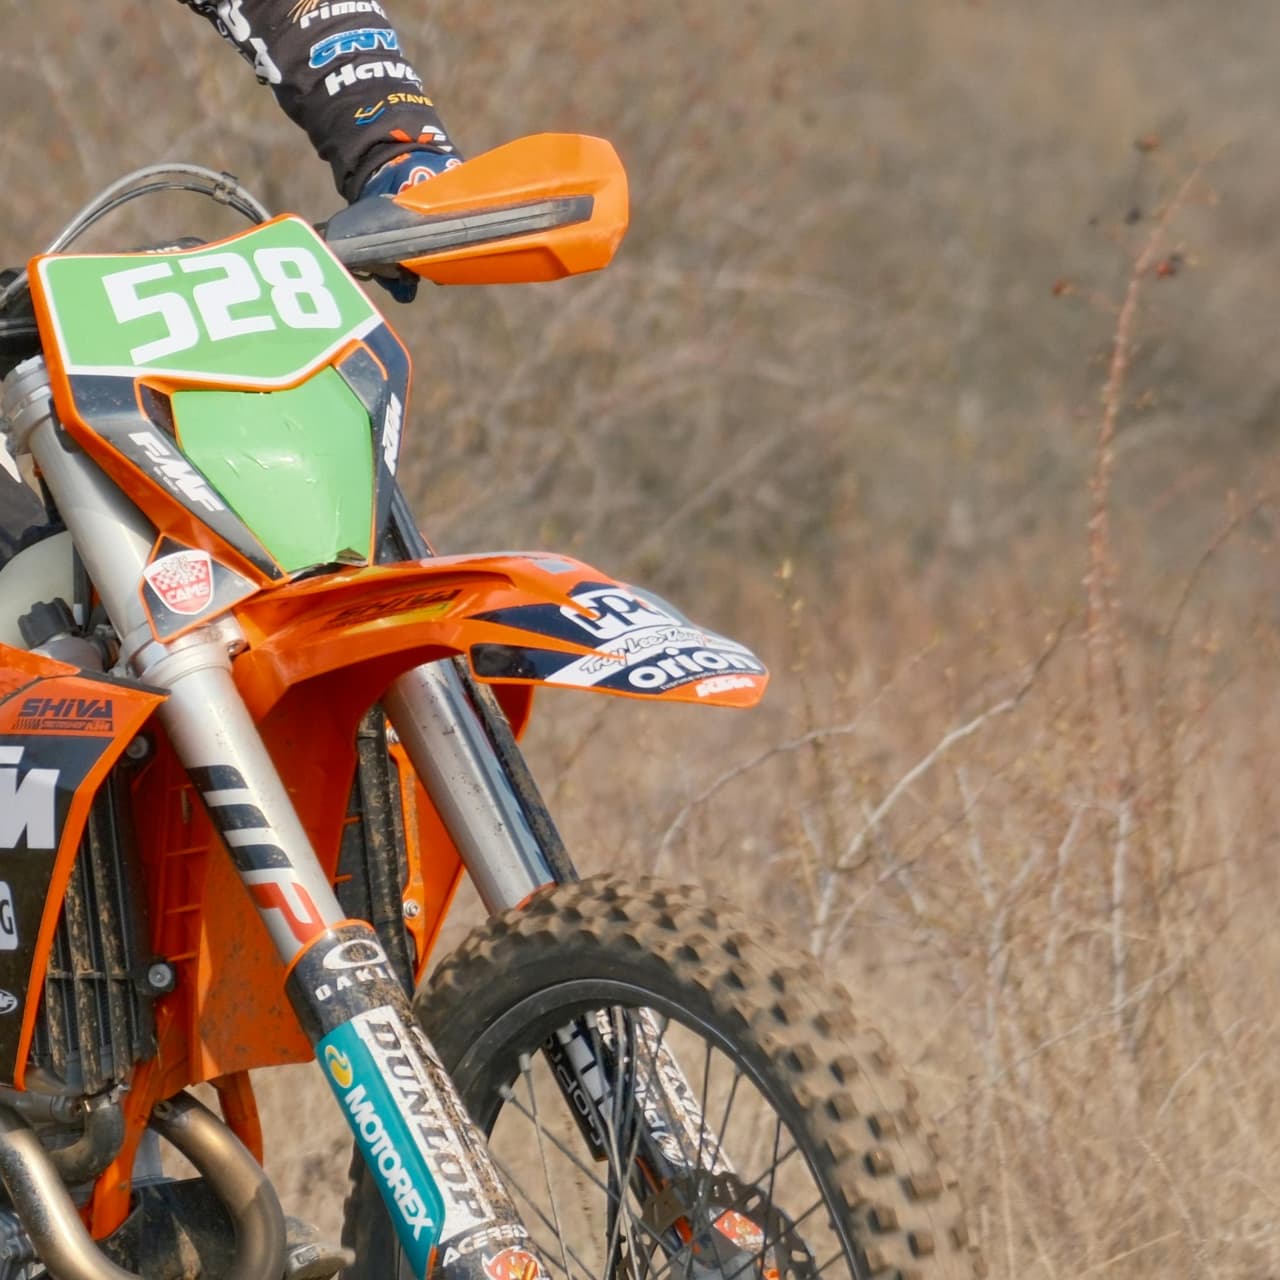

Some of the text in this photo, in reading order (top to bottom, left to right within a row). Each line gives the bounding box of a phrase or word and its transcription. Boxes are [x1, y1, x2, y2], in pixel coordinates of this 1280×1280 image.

[101, 247, 342, 366] 528
[127, 431, 226, 512] FMF
[628, 647, 762, 690] orion
[344, 1087, 436, 1241] MOTOREX
[365, 1017, 493, 1221] DUNLOP
